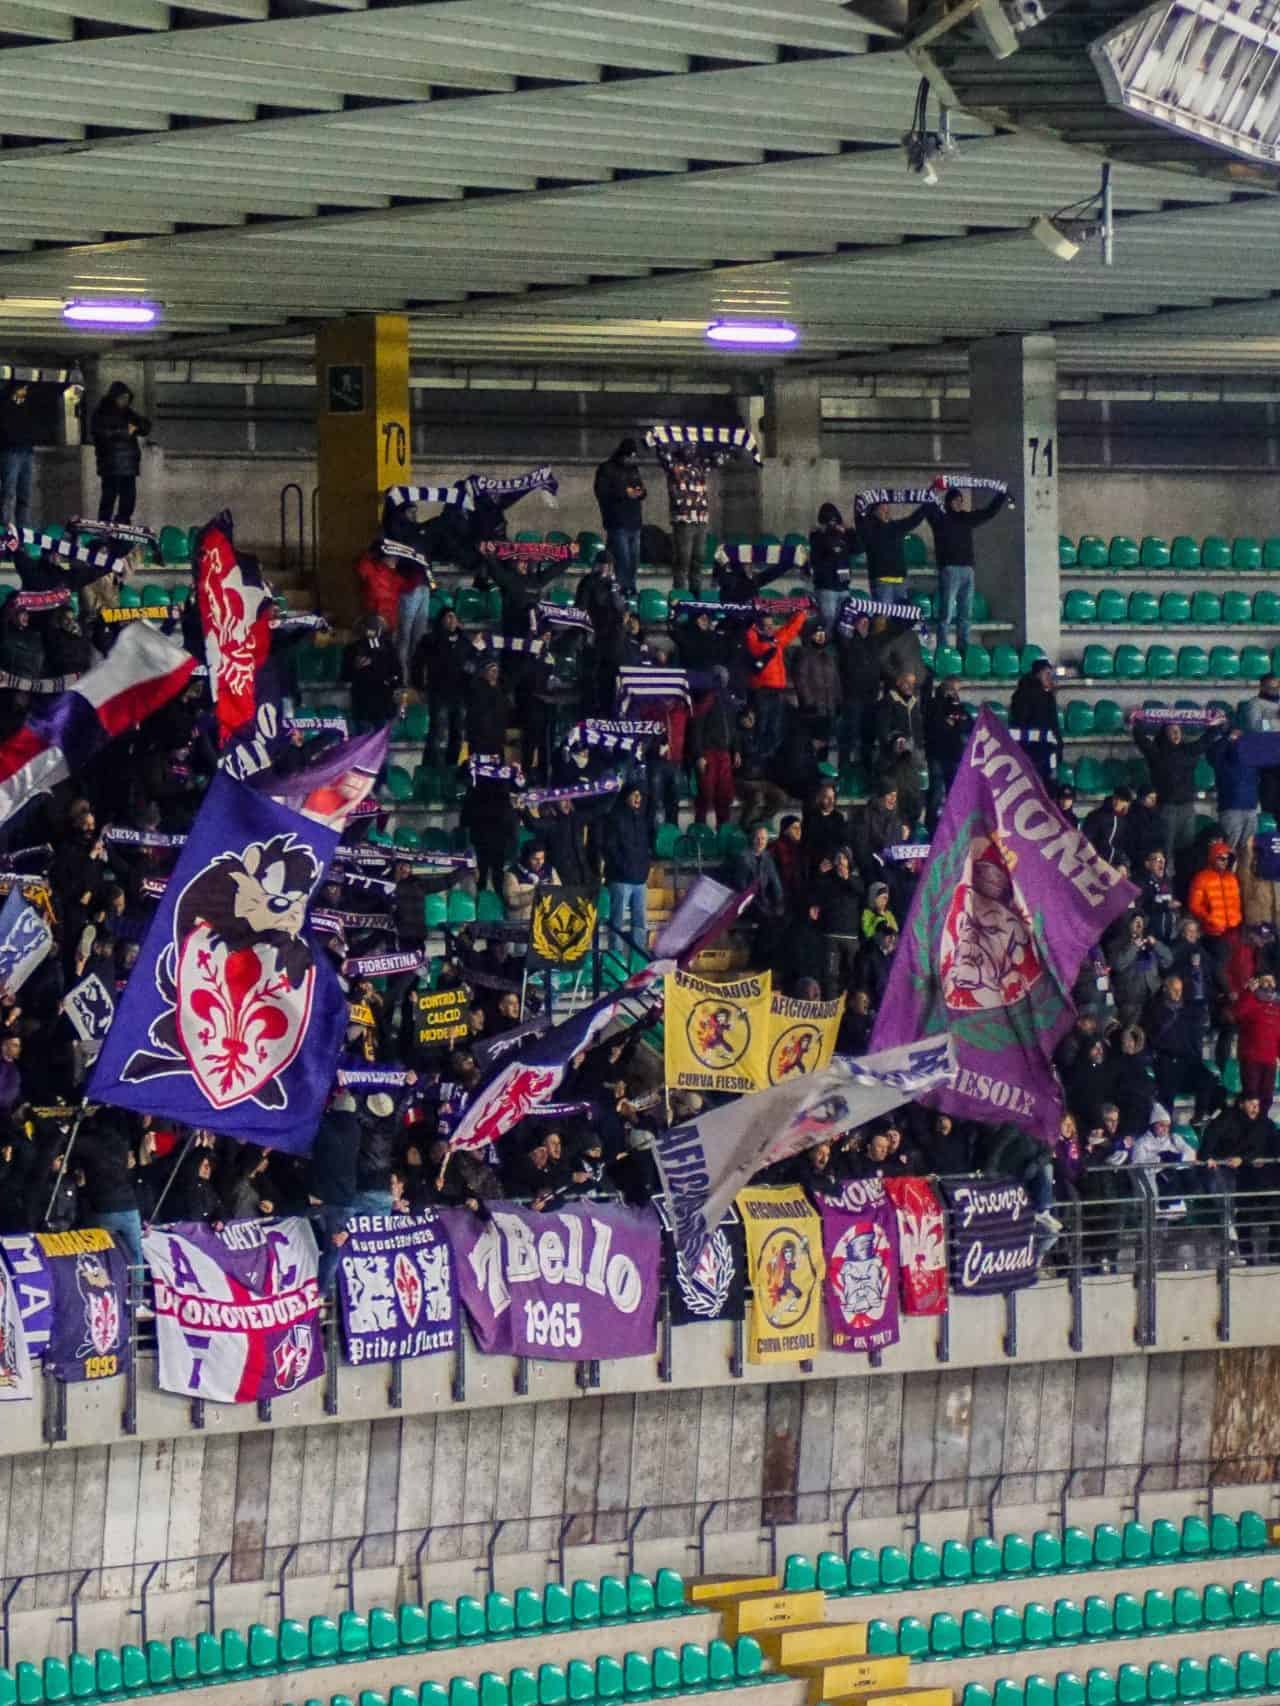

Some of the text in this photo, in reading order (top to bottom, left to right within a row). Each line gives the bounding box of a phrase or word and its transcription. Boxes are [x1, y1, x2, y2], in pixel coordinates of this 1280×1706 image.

[382, 421, 407, 466] 70
[1028, 437, 1054, 477] 71
[358, 953, 418, 974] FIORENTINA
[955, 1186, 1029, 1228] Firenze
[963, 1234, 1038, 1288] Casual
[524, 1299, 583, 1349] 1965
[83, 1355, 119, 1379] 1993
